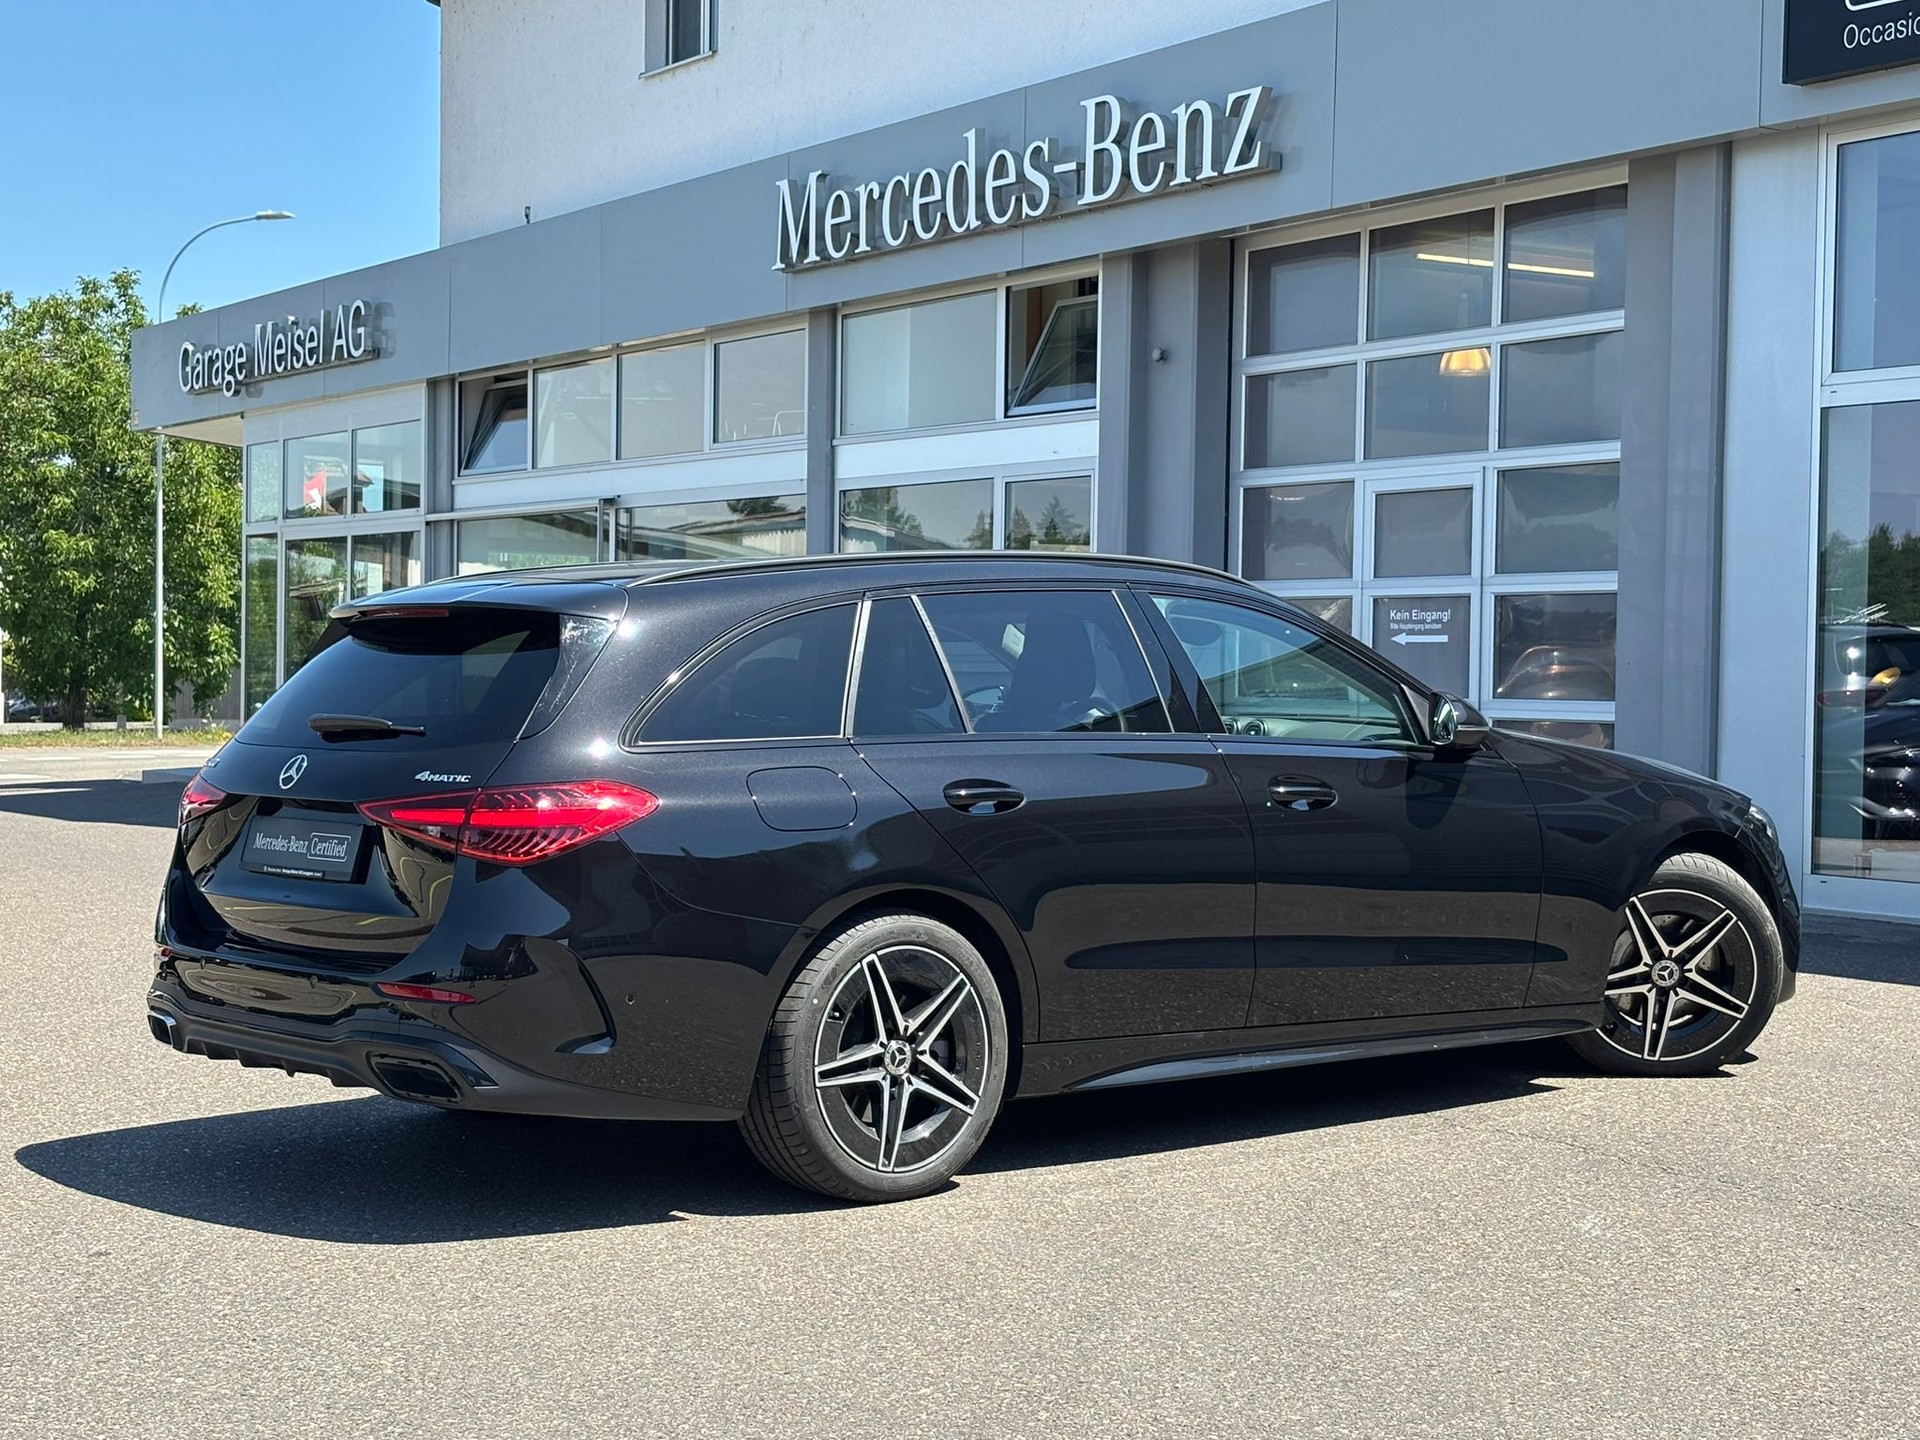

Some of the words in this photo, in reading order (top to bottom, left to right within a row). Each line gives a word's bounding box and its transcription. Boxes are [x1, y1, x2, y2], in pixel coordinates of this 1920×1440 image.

[771, 85, 1268, 271] Mercedes-Benz
[179, 341, 247, 398] Garage
[254, 309, 324, 377] Meisel
[331, 299, 365, 362] AG
[1390, 609, 1410, 620] Kein
[1412, 609, 1451, 622] Eingang!
[414, 770, 472, 783] 4MATIC
[253, 832, 308, 854] Mercedes-Benz
[310, 838, 348, 858] Certified
